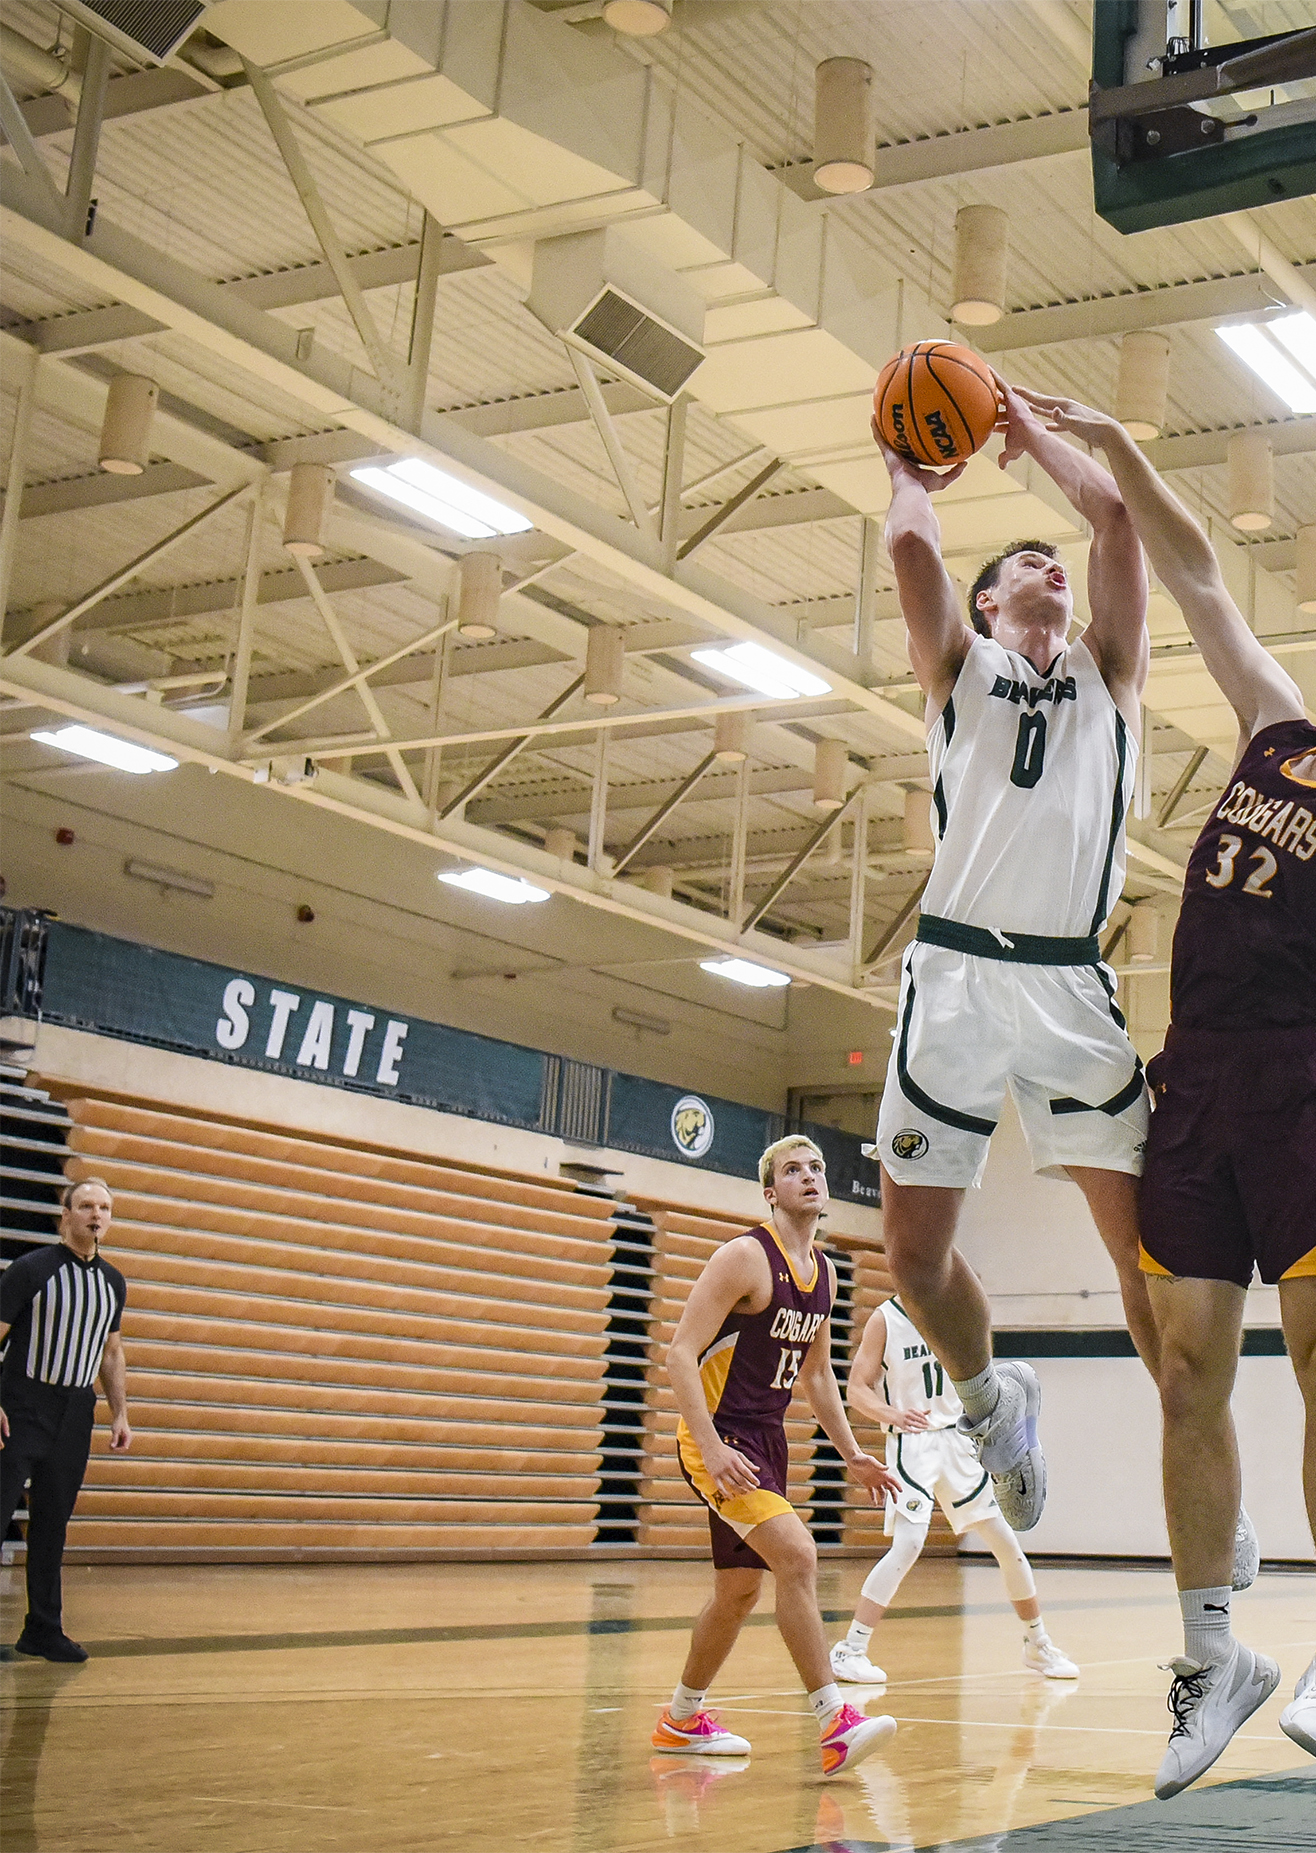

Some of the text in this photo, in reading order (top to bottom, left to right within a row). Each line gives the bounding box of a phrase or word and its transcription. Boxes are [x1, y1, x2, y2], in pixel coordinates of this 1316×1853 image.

[1010, 710, 1047, 789] 0
[1205, 833, 1278, 899] 32
[215, 978, 410, 1087] STATE
[769, 1347, 803, 1389] 15
[922, 1360, 944, 1399] 11
